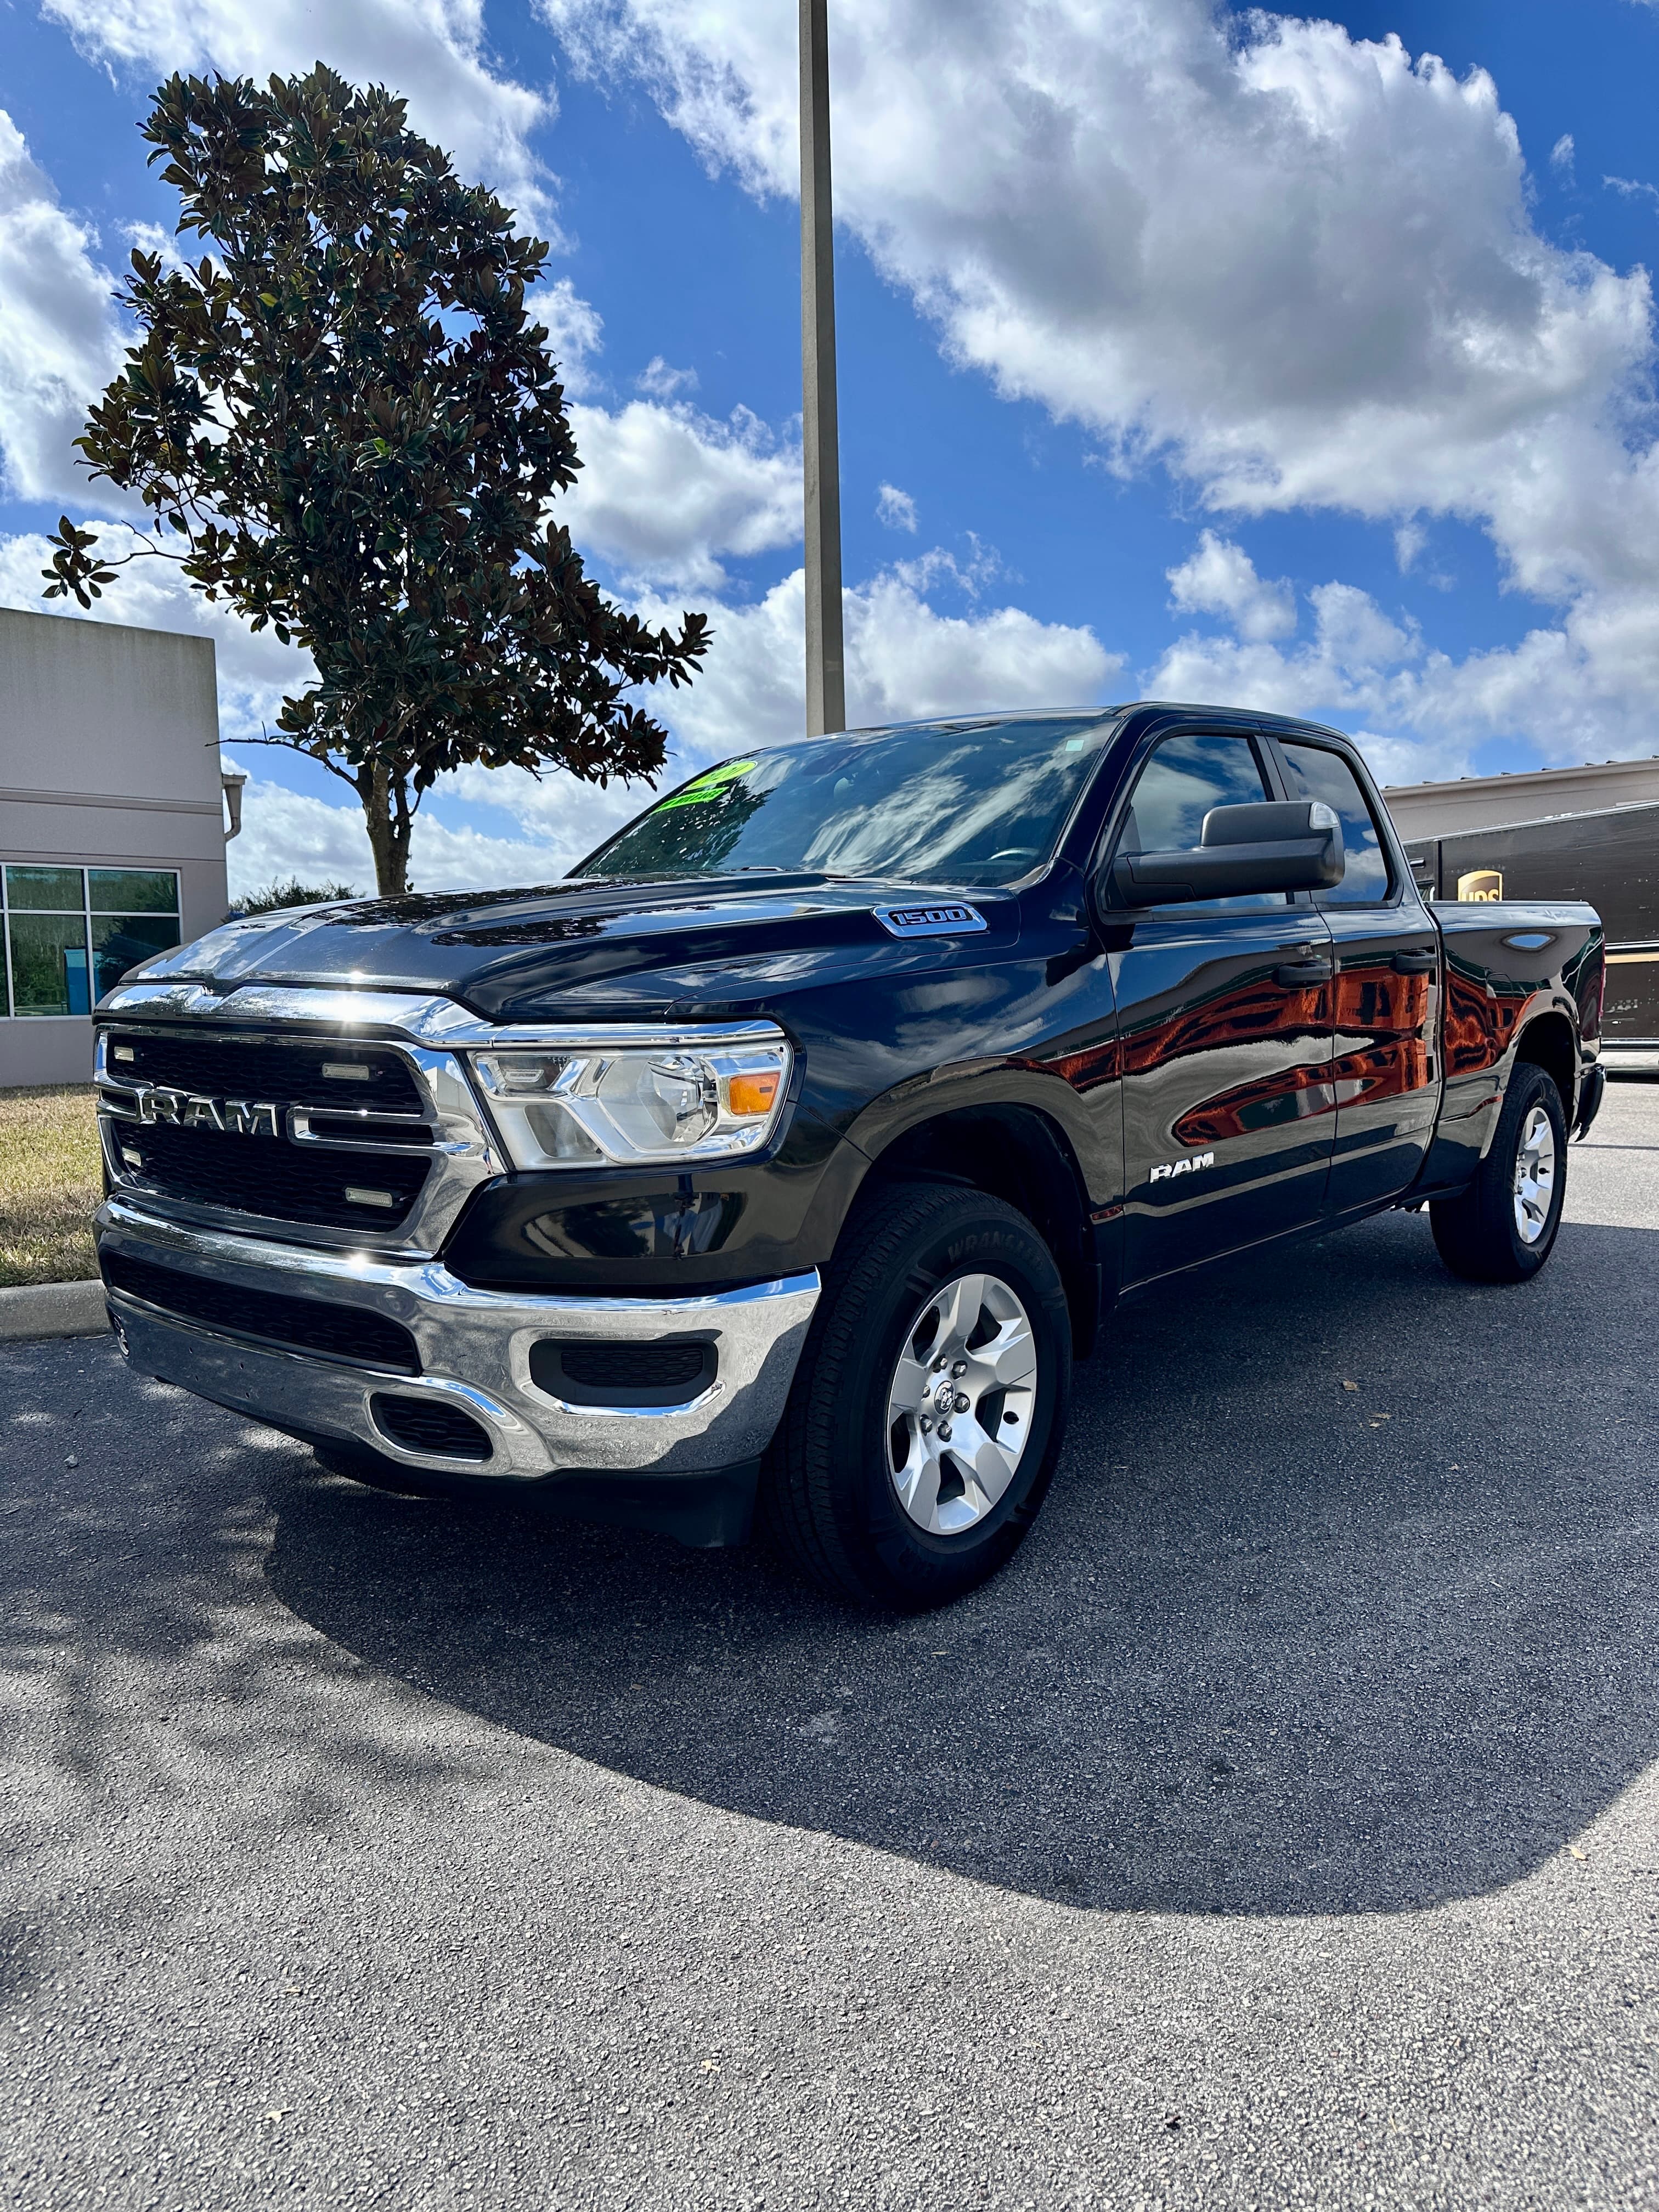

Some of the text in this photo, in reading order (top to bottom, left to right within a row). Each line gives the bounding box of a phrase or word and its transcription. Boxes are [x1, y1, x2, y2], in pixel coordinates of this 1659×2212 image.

[891, 909, 967, 925] 1500
[141, 1090, 278, 1137] RAM
[1149, 1151, 1214, 1183] RAM
